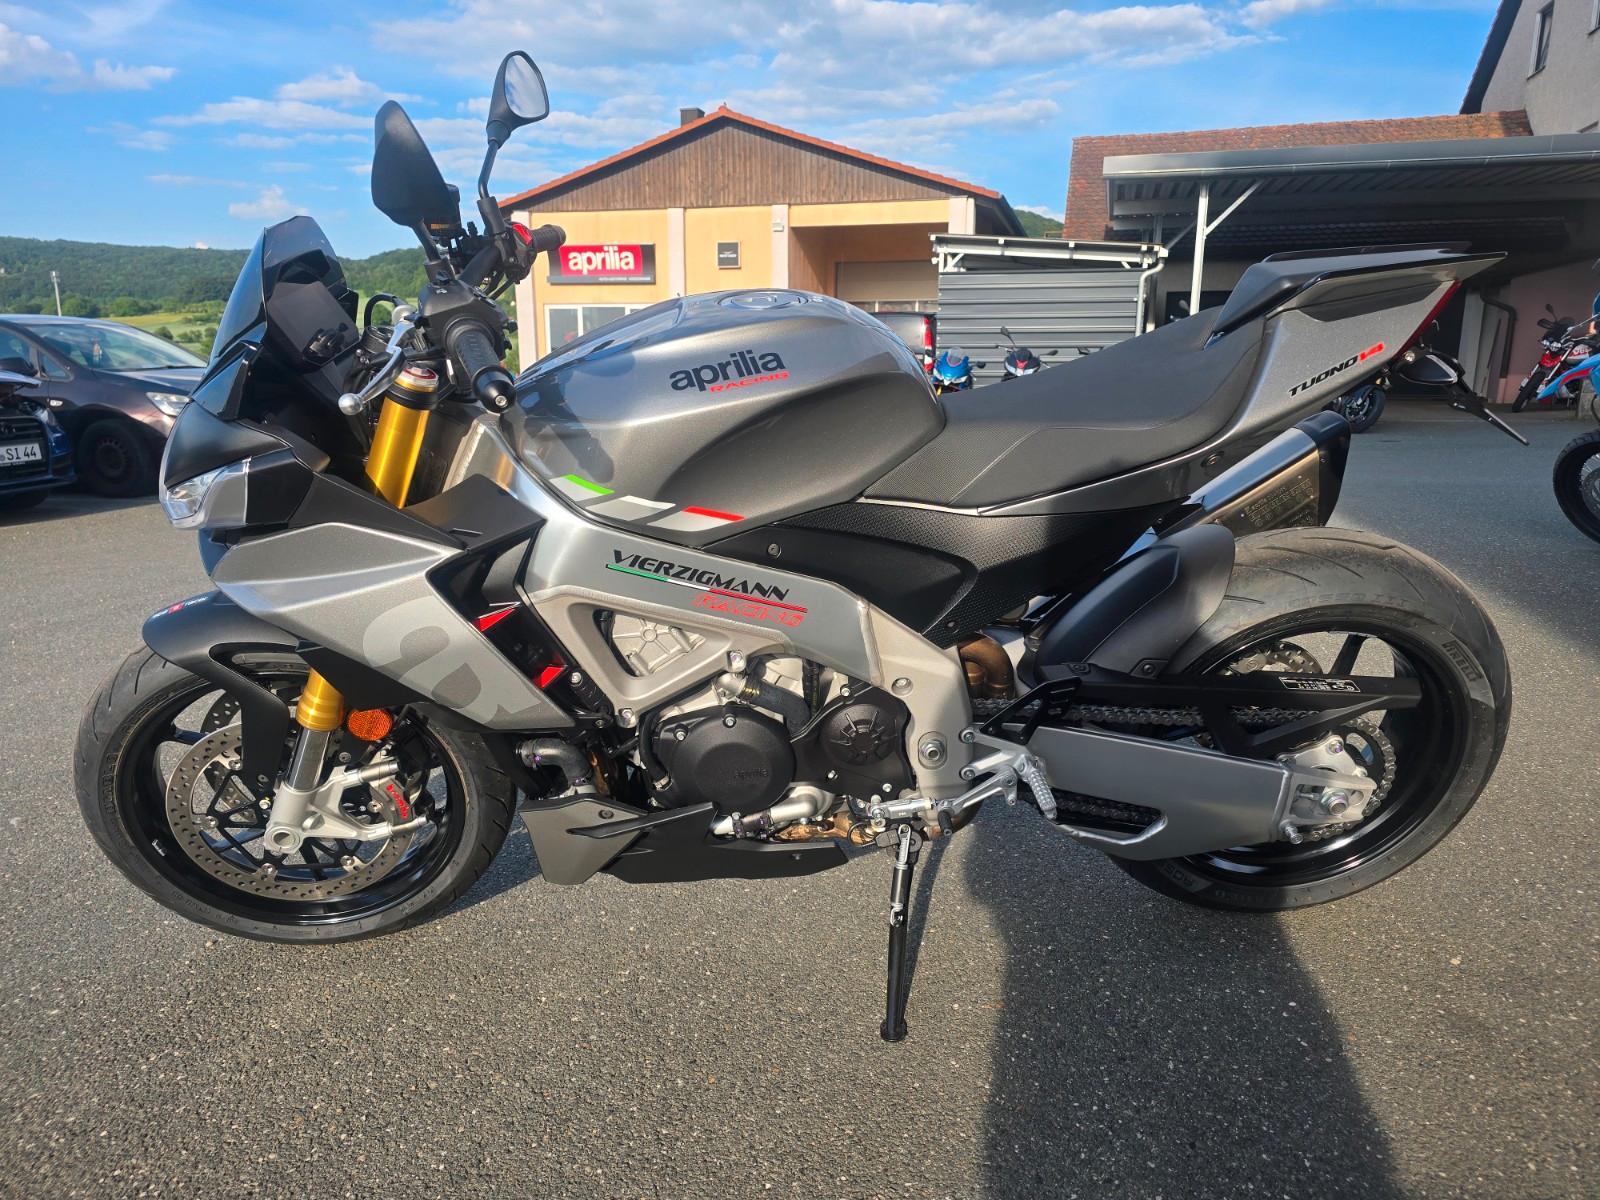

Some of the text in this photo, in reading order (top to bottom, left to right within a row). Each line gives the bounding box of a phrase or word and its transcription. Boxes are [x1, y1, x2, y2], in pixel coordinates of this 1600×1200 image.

[567, 244, 635, 275] aprilia
[668, 349, 787, 392] aprilia
[709, 370, 790, 393] RACING
[1288, 354, 1359, 397] TUONO
[23, 445, 37, 459] 44
[613, 549, 790, 601] VIERZIGMANN
[1441, 639, 1484, 682] PIRELLI
